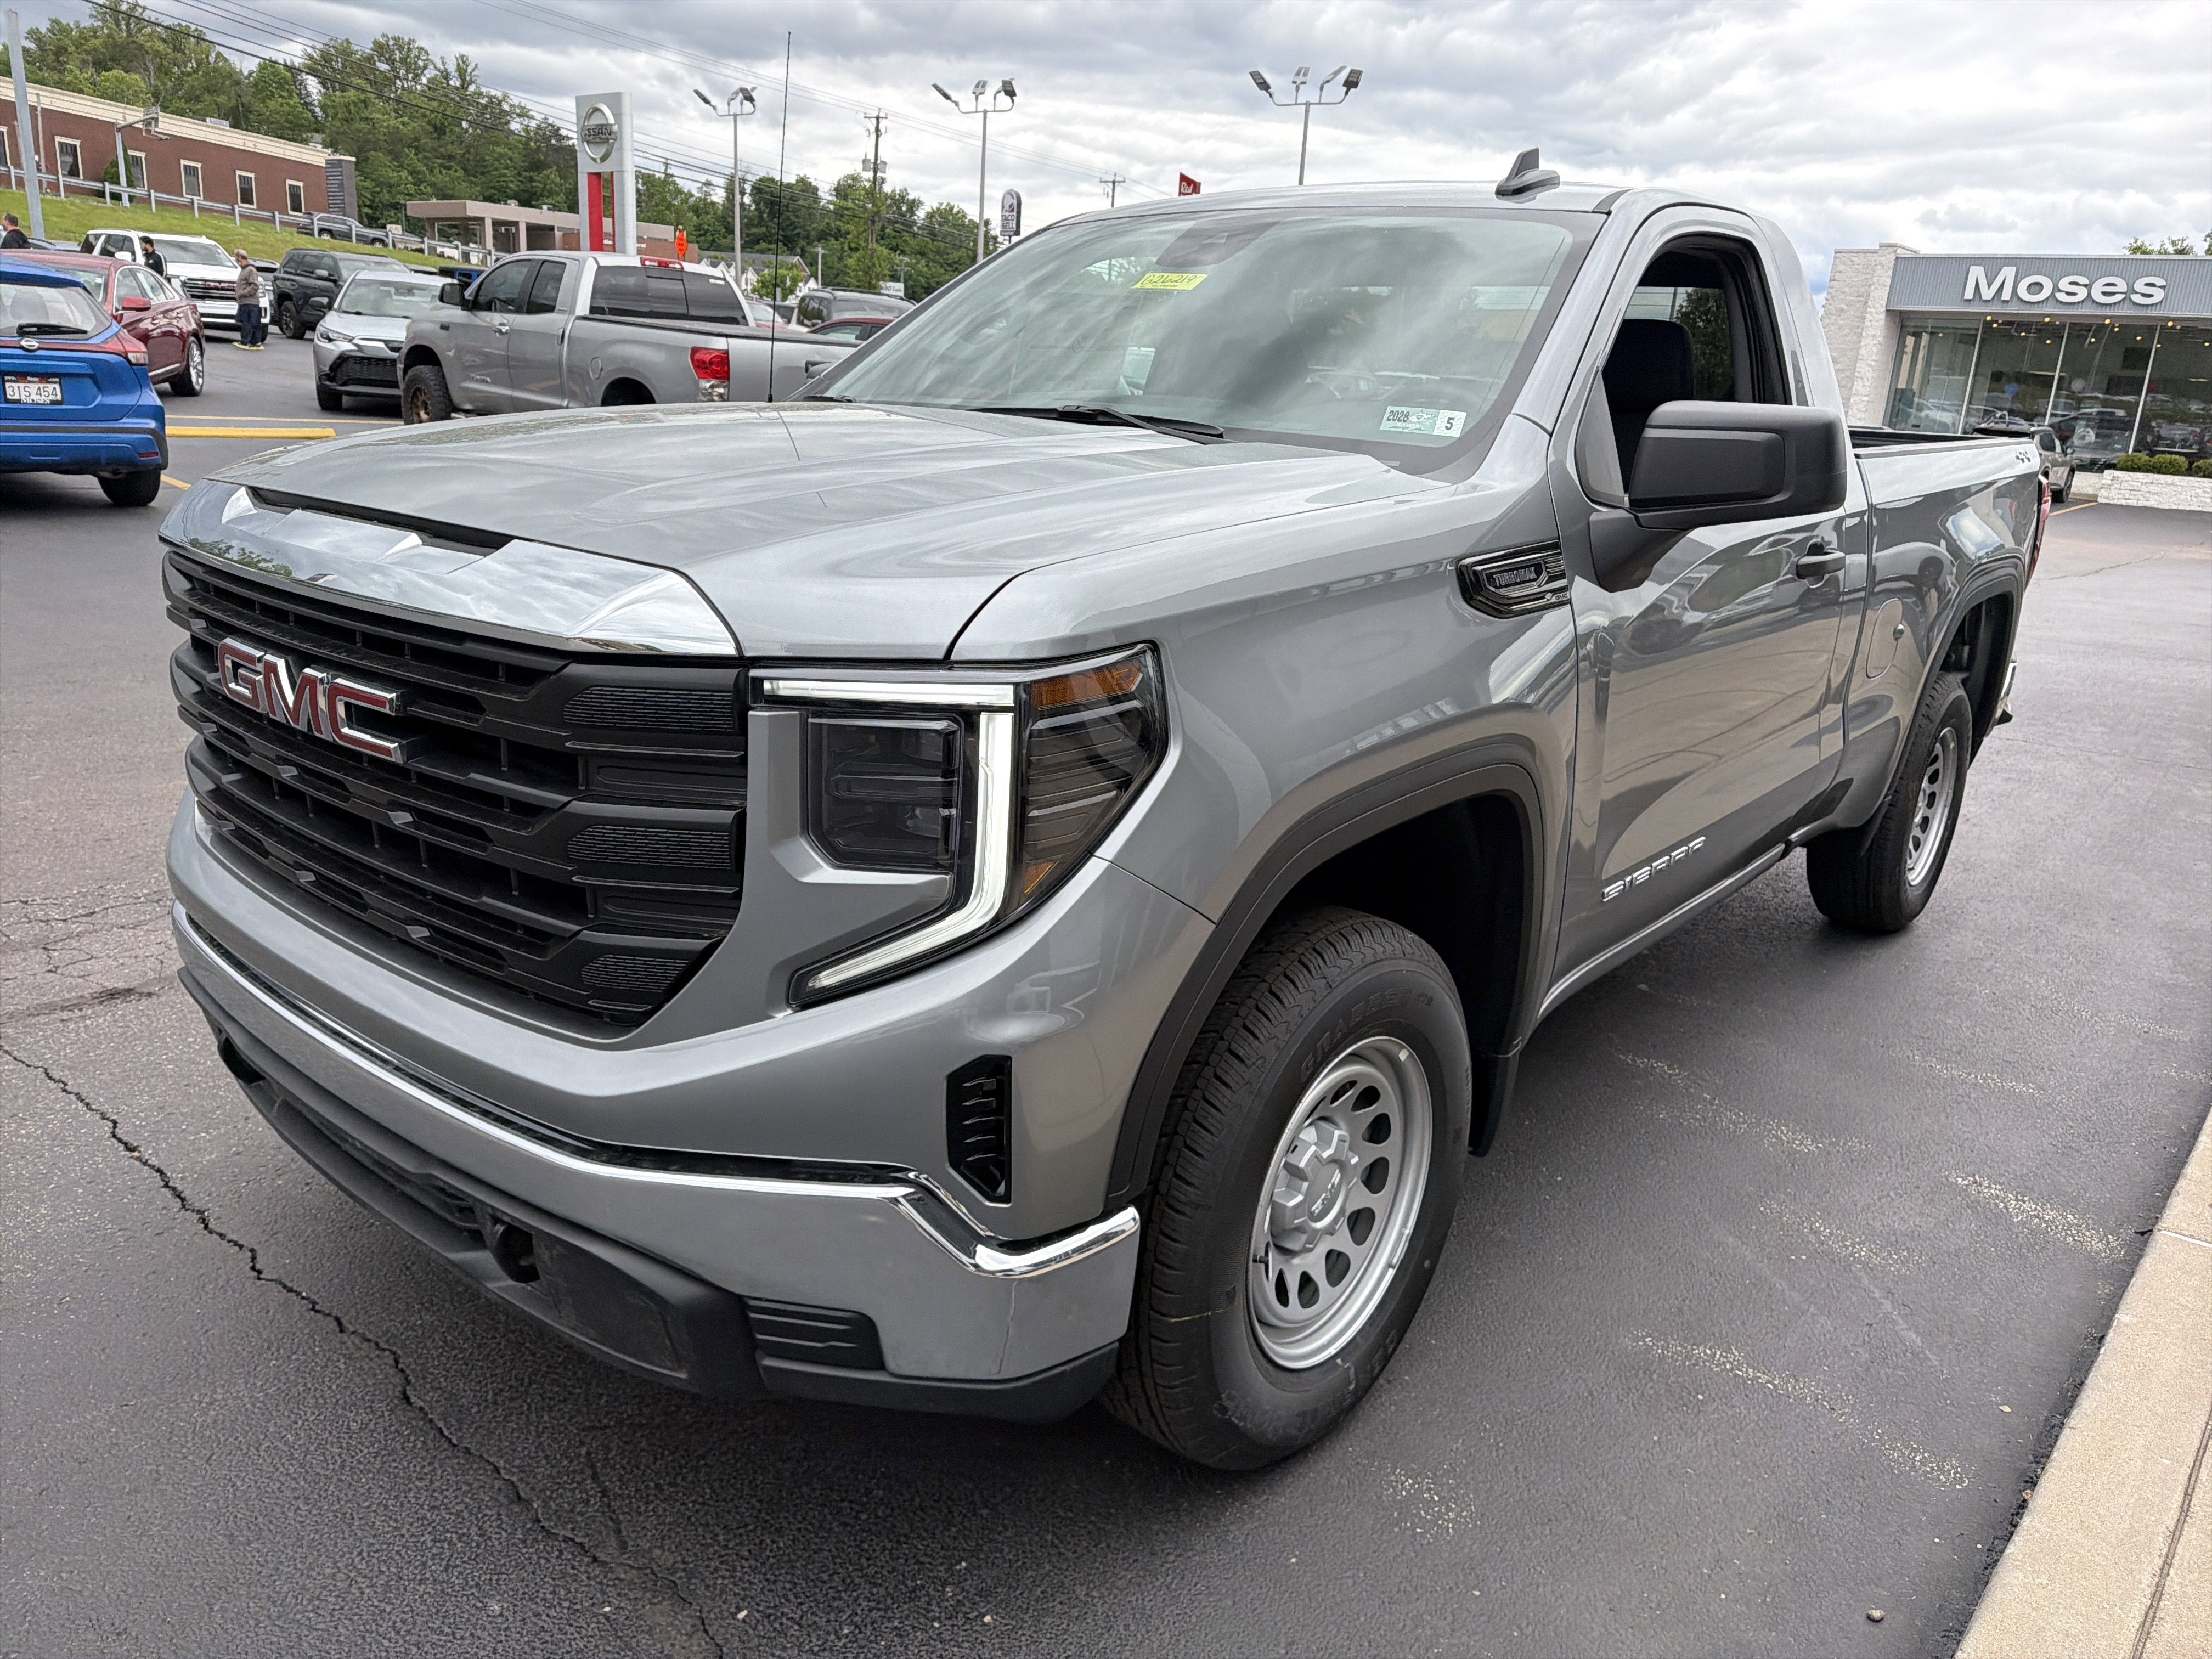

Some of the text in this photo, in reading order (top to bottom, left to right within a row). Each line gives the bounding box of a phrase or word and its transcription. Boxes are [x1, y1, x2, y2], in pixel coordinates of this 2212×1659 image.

[582, 127, 612, 137] SSAN
[1963, 266, 2167, 305] Moses
[35, 386, 58, 398] 454
[1386, 410, 1410, 423] 2028
[1444, 417, 1455, 431] 5
[1493, 566, 1538, 588] TURBOMAX
[1555, 592, 1568, 601] GMC
[218, 637, 407, 765] GMC
[1601, 836, 1707, 902] SIERRA
